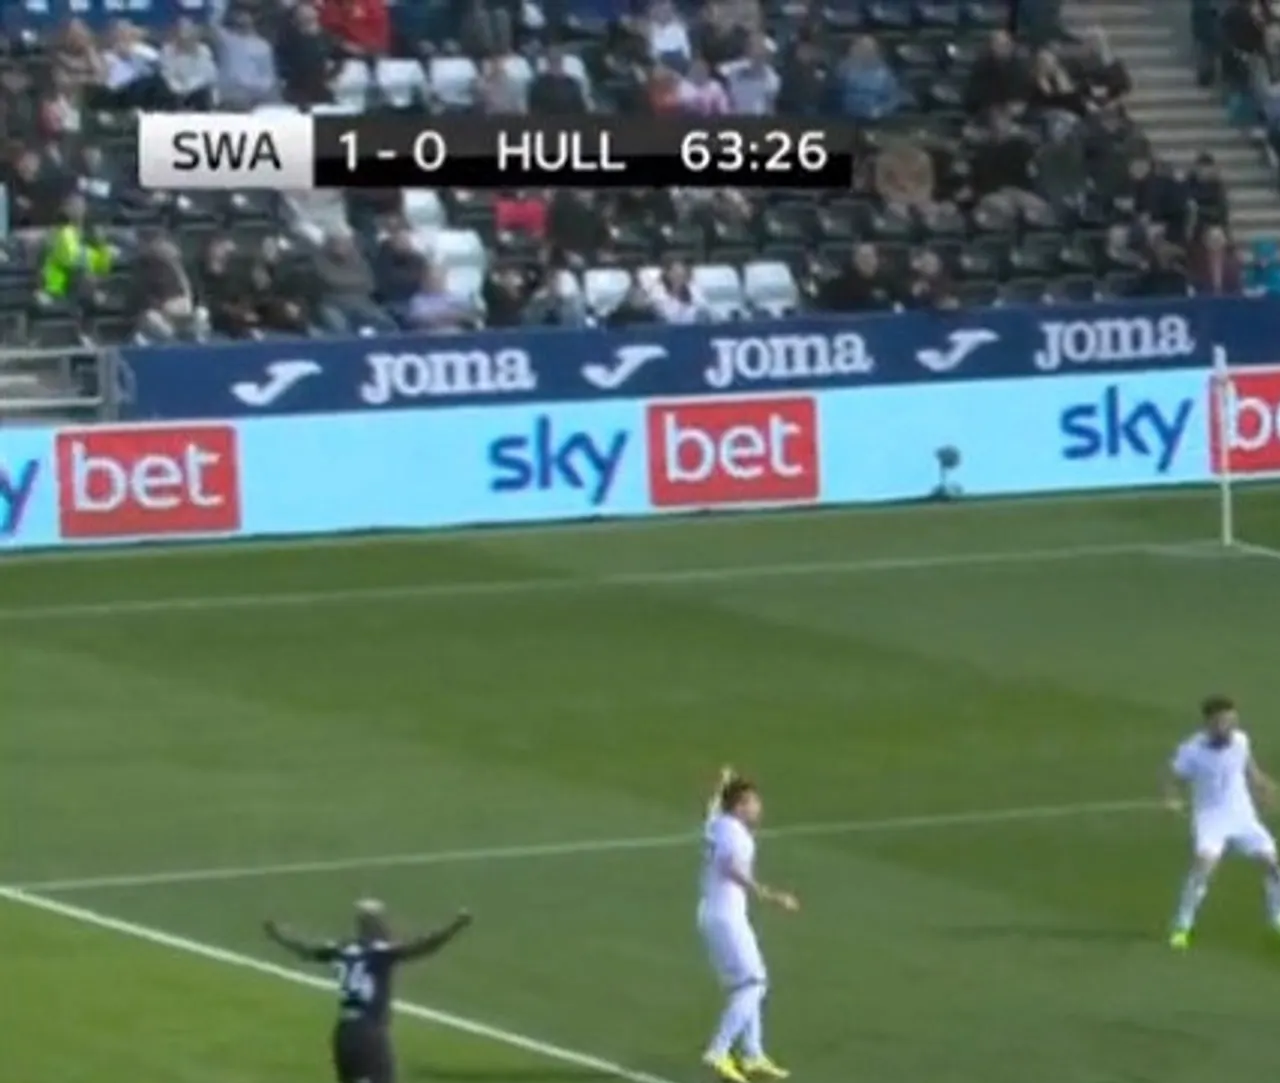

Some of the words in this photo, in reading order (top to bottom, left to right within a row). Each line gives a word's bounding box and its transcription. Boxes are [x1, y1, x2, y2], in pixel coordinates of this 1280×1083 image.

[488, 414, 628, 505] sky
[664, 411, 803, 482] bet
[1060, 384, 1193, 473] sky
[71, 440, 225, 512] bet
